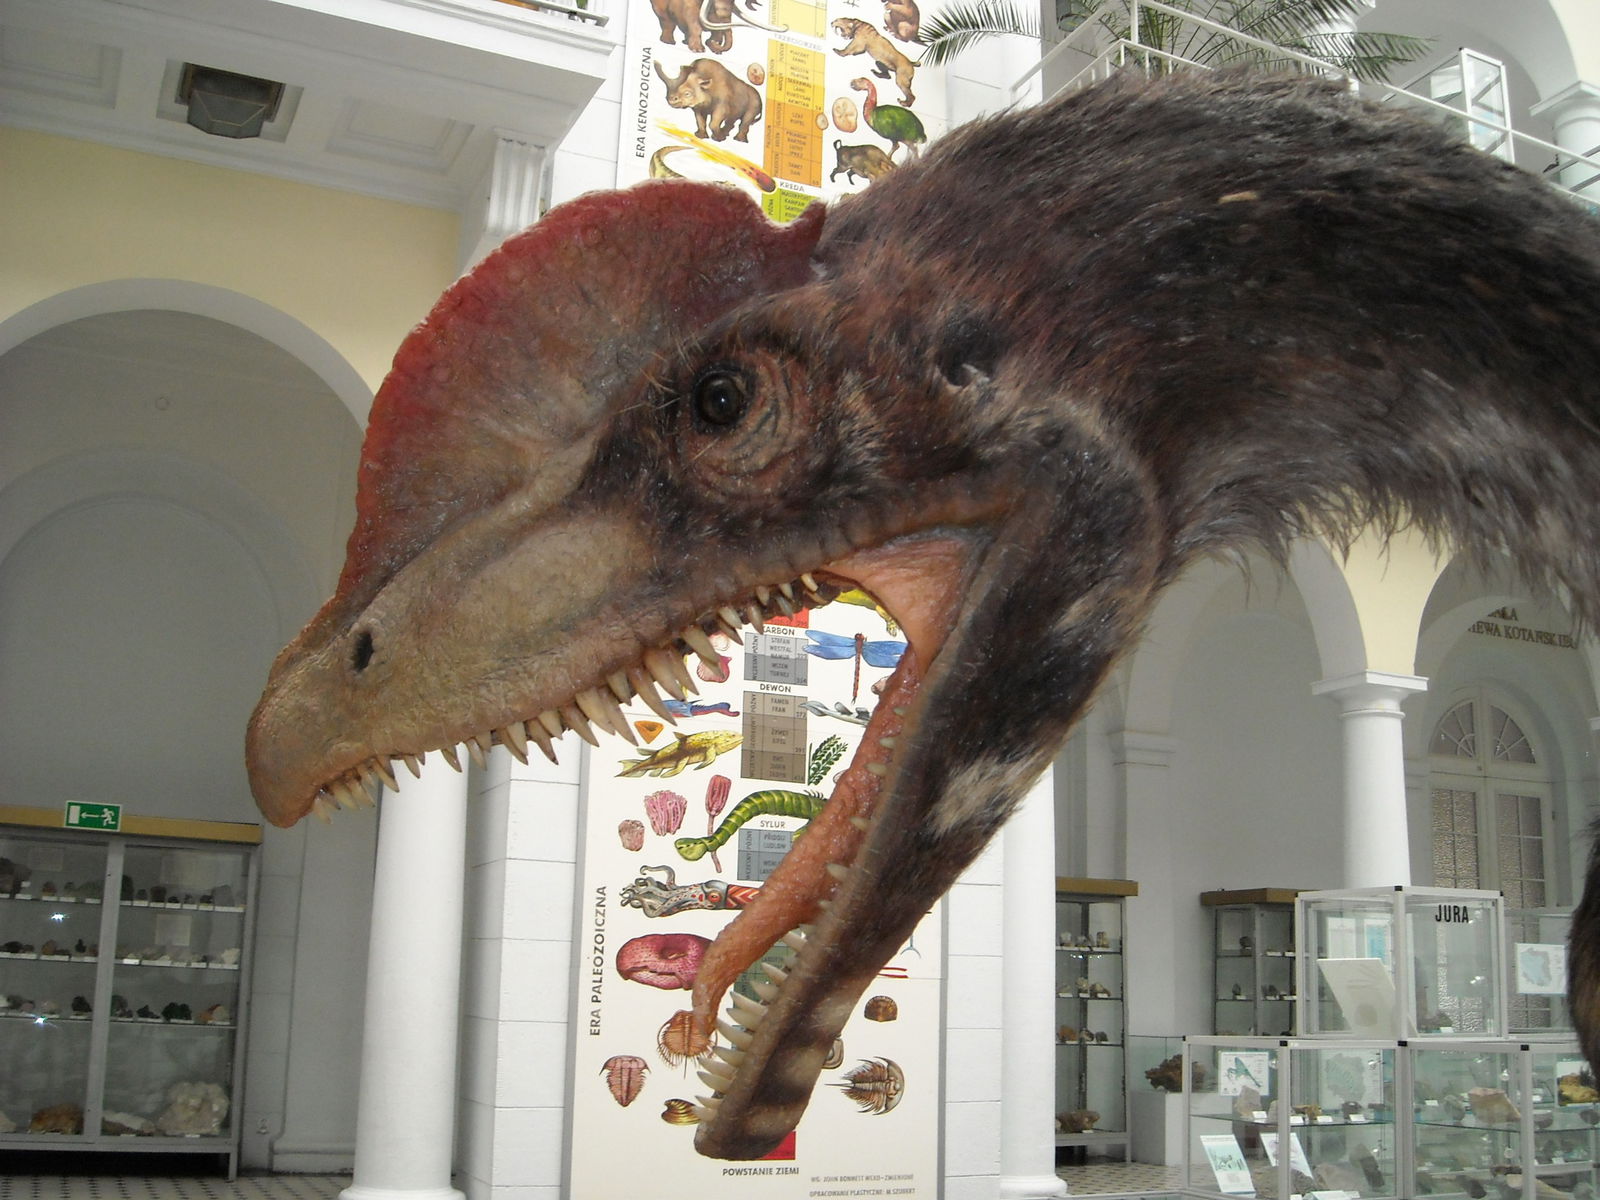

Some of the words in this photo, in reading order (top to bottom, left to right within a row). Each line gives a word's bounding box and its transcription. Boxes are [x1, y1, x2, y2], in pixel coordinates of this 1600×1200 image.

[637, 47, 652, 132] KENOZOICZNA
[635, 136, 646, 158] ERA
[780, 181, 805, 193] KREDA
[760, 683, 791, 692] DEWON
[760, 820, 786, 829] SYLUR
[1435, 904, 1469, 923] JURA
[591, 886, 607, 1003] PALEOZOICZNA
[590, 1009, 601, 1036] ERA
[722, 1168, 773, 1176] POWSTANIE
[775, 1167, 800, 1175] ZIEMI
